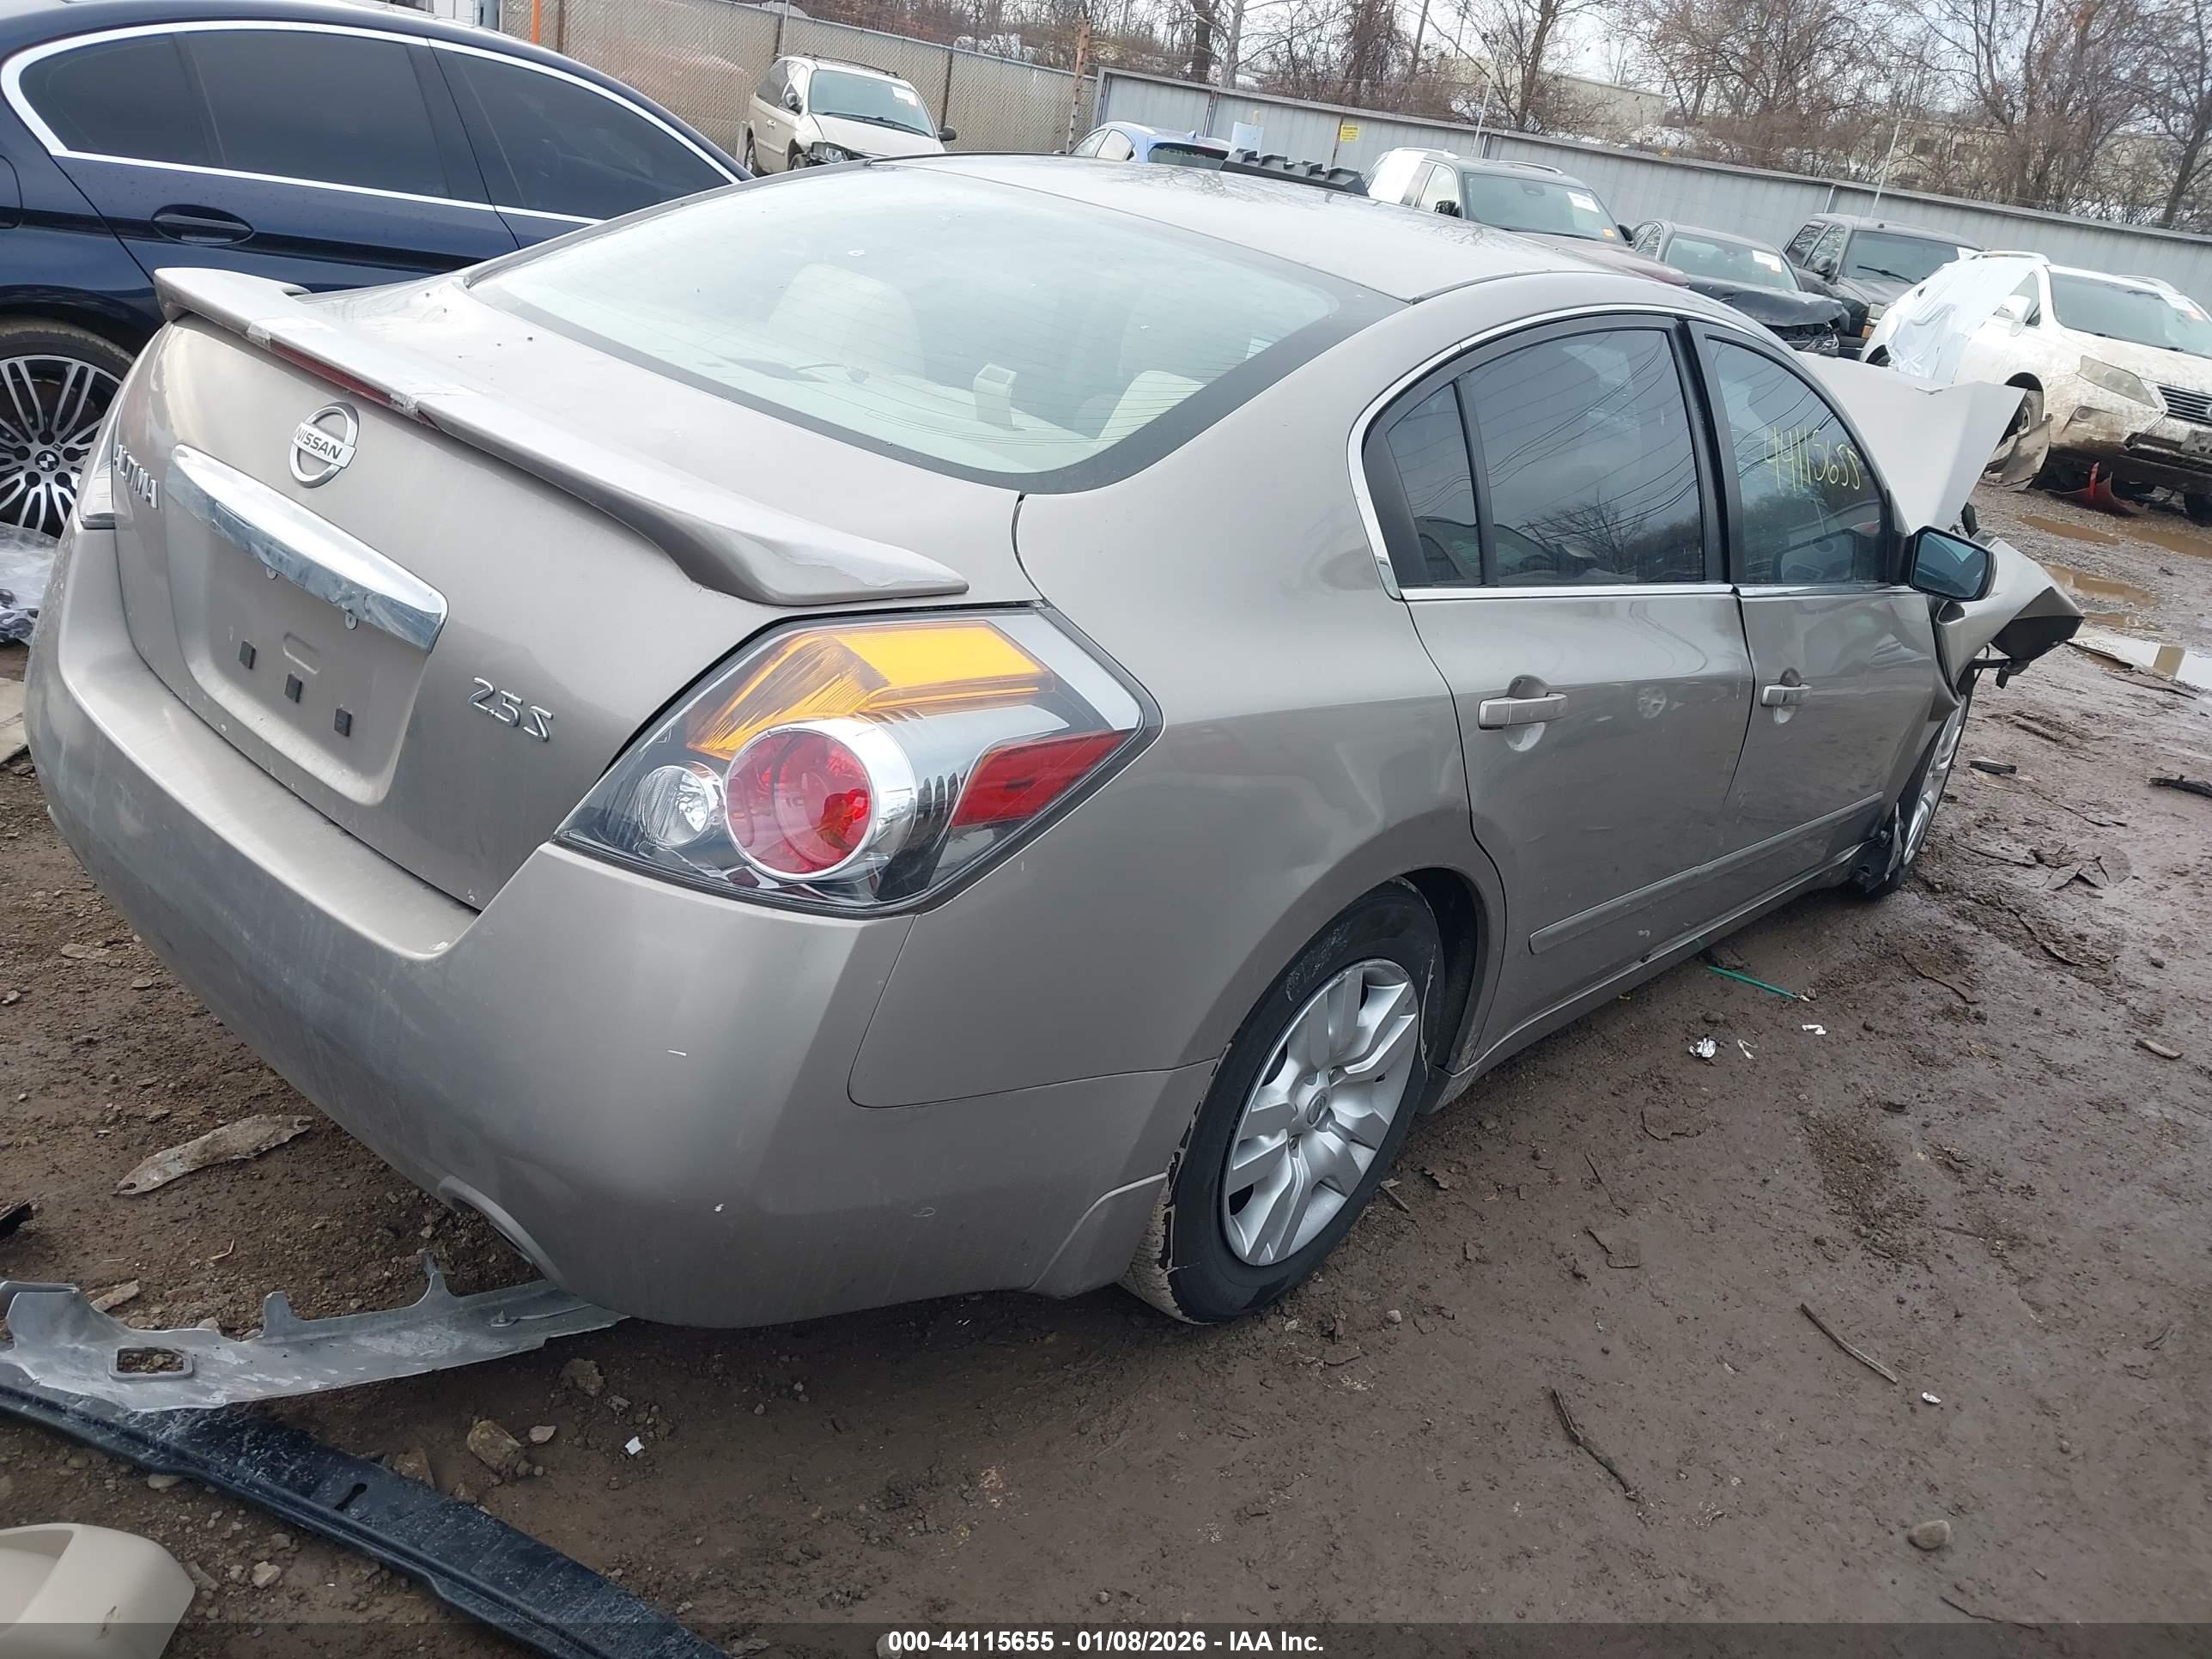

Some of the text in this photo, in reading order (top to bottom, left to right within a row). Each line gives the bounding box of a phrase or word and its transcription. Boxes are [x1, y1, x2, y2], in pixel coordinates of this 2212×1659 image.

[295, 427, 343, 460] NISSAN
[1763, 425, 1861, 491] 44115655
[522, 705, 554, 743] S
